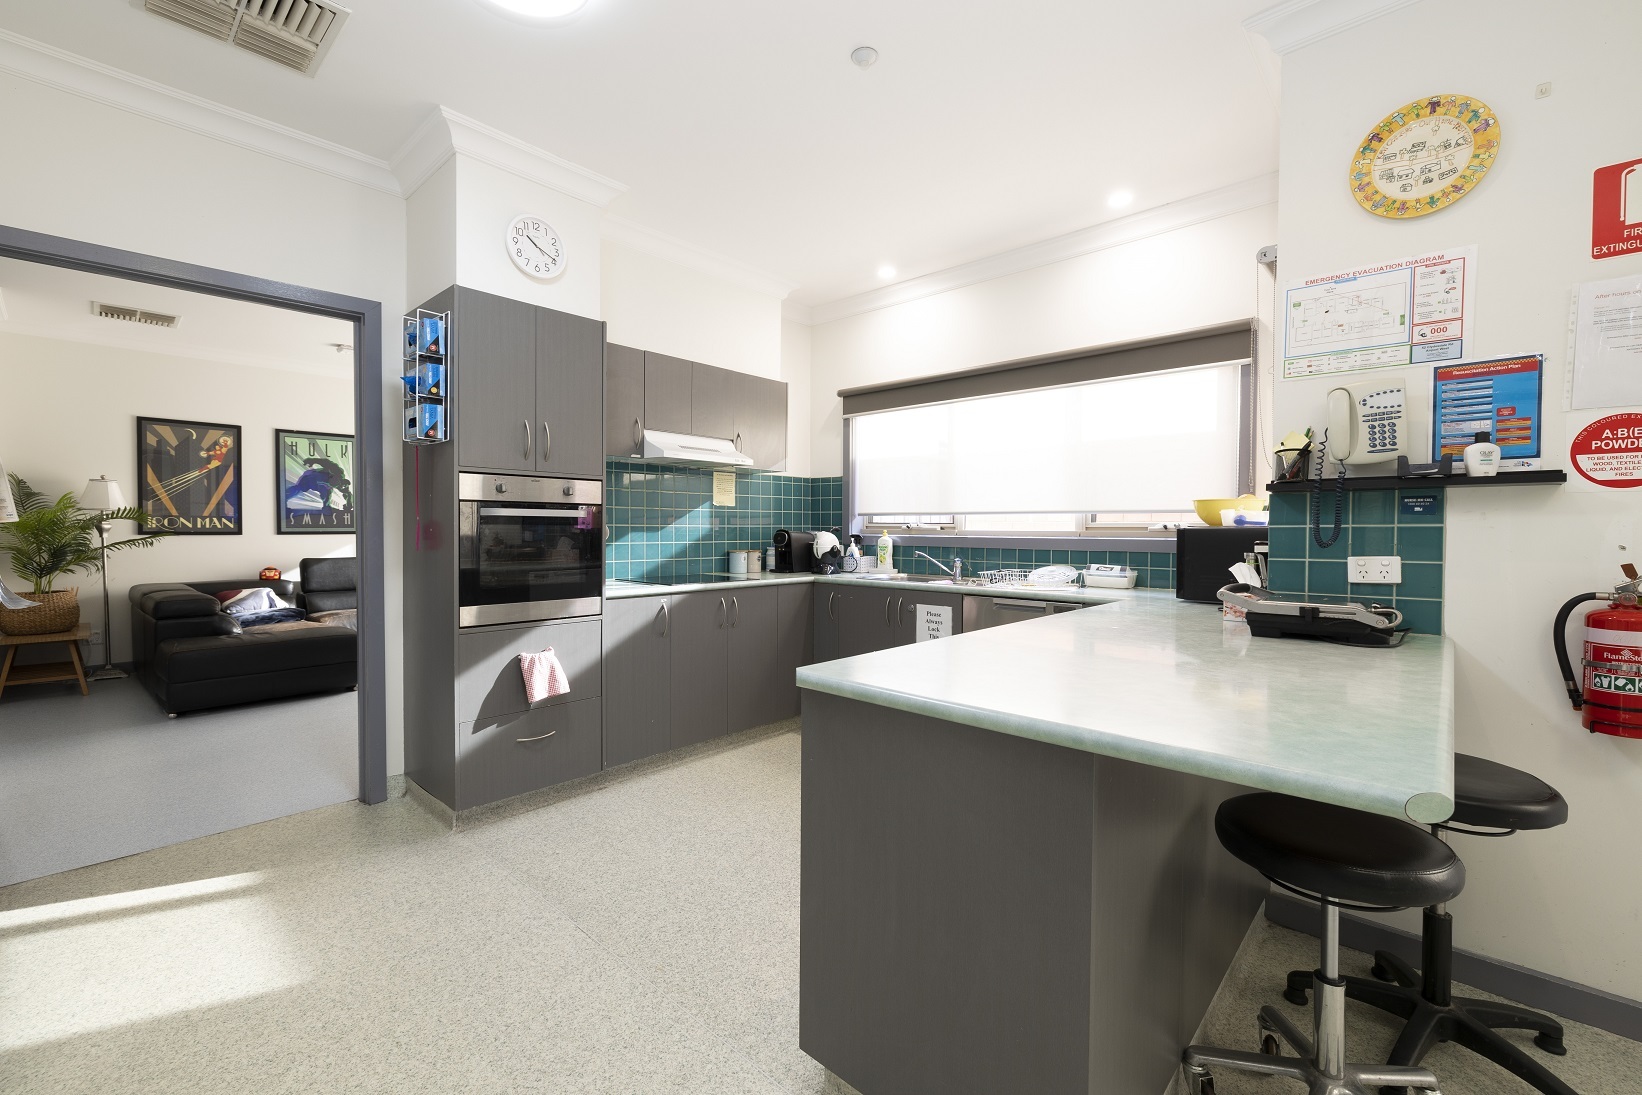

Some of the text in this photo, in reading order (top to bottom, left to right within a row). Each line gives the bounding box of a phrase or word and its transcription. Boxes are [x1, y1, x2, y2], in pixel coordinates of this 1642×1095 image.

[515, 226, 524, 236] 10
[523, 220, 529, 230] 11
[532, 220, 540, 231] 12
[1305, 272, 1350, 286] EMERGENCY
[1352, 262, 1402, 276] EVACUATION
[1405, 254, 1445, 267] DIAGRAM
[1430, 326, 1448, 334] 000
[1576, 431, 1588, 442] THIS
[1587, 414, 1628, 431] COLOURED
[289, 441, 348, 458] HULK
[148, 516, 234, 531] IRON MAN
[290, 512, 351, 524] SMASH
